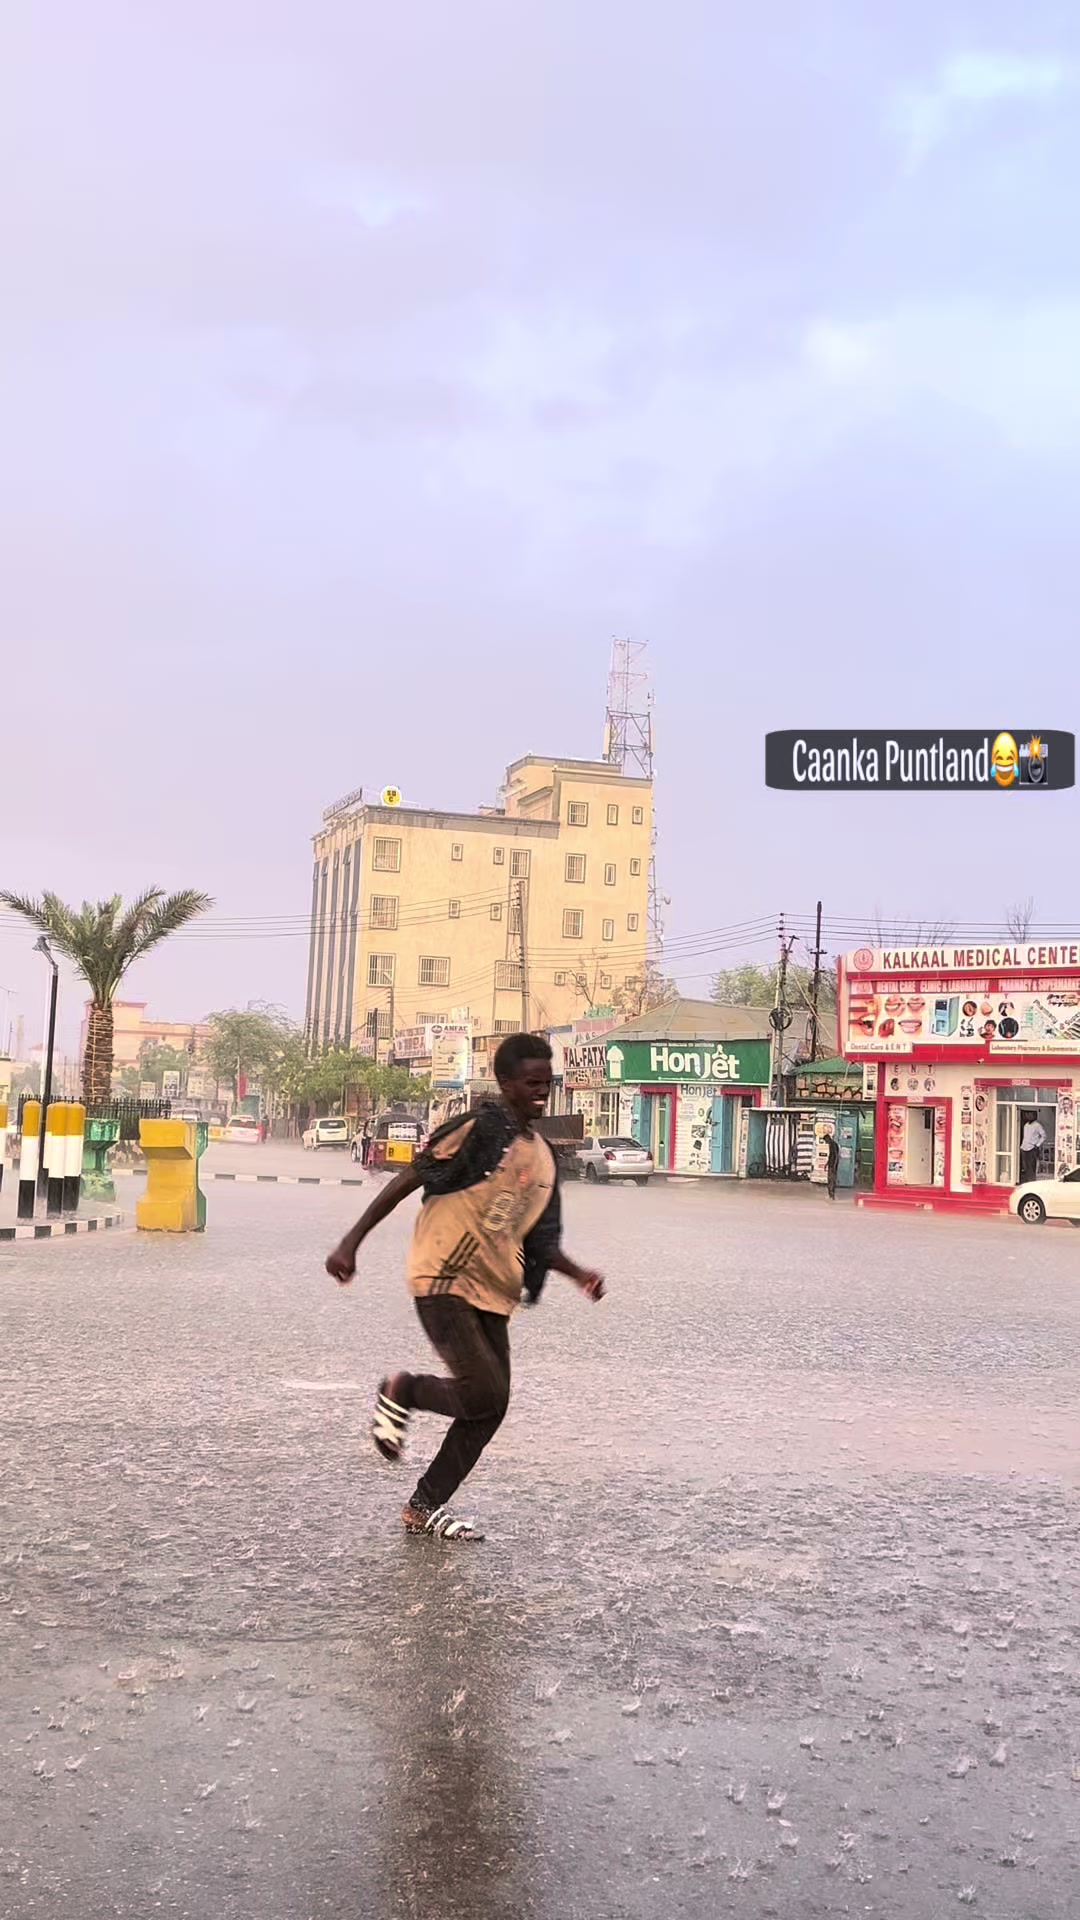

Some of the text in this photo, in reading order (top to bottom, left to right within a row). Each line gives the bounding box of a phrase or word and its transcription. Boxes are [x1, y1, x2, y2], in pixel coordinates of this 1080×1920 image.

[883, 945, 1078, 969] KALKAAL MEDICAL CENTE
[893, 1064, 933, 1073] E N T
